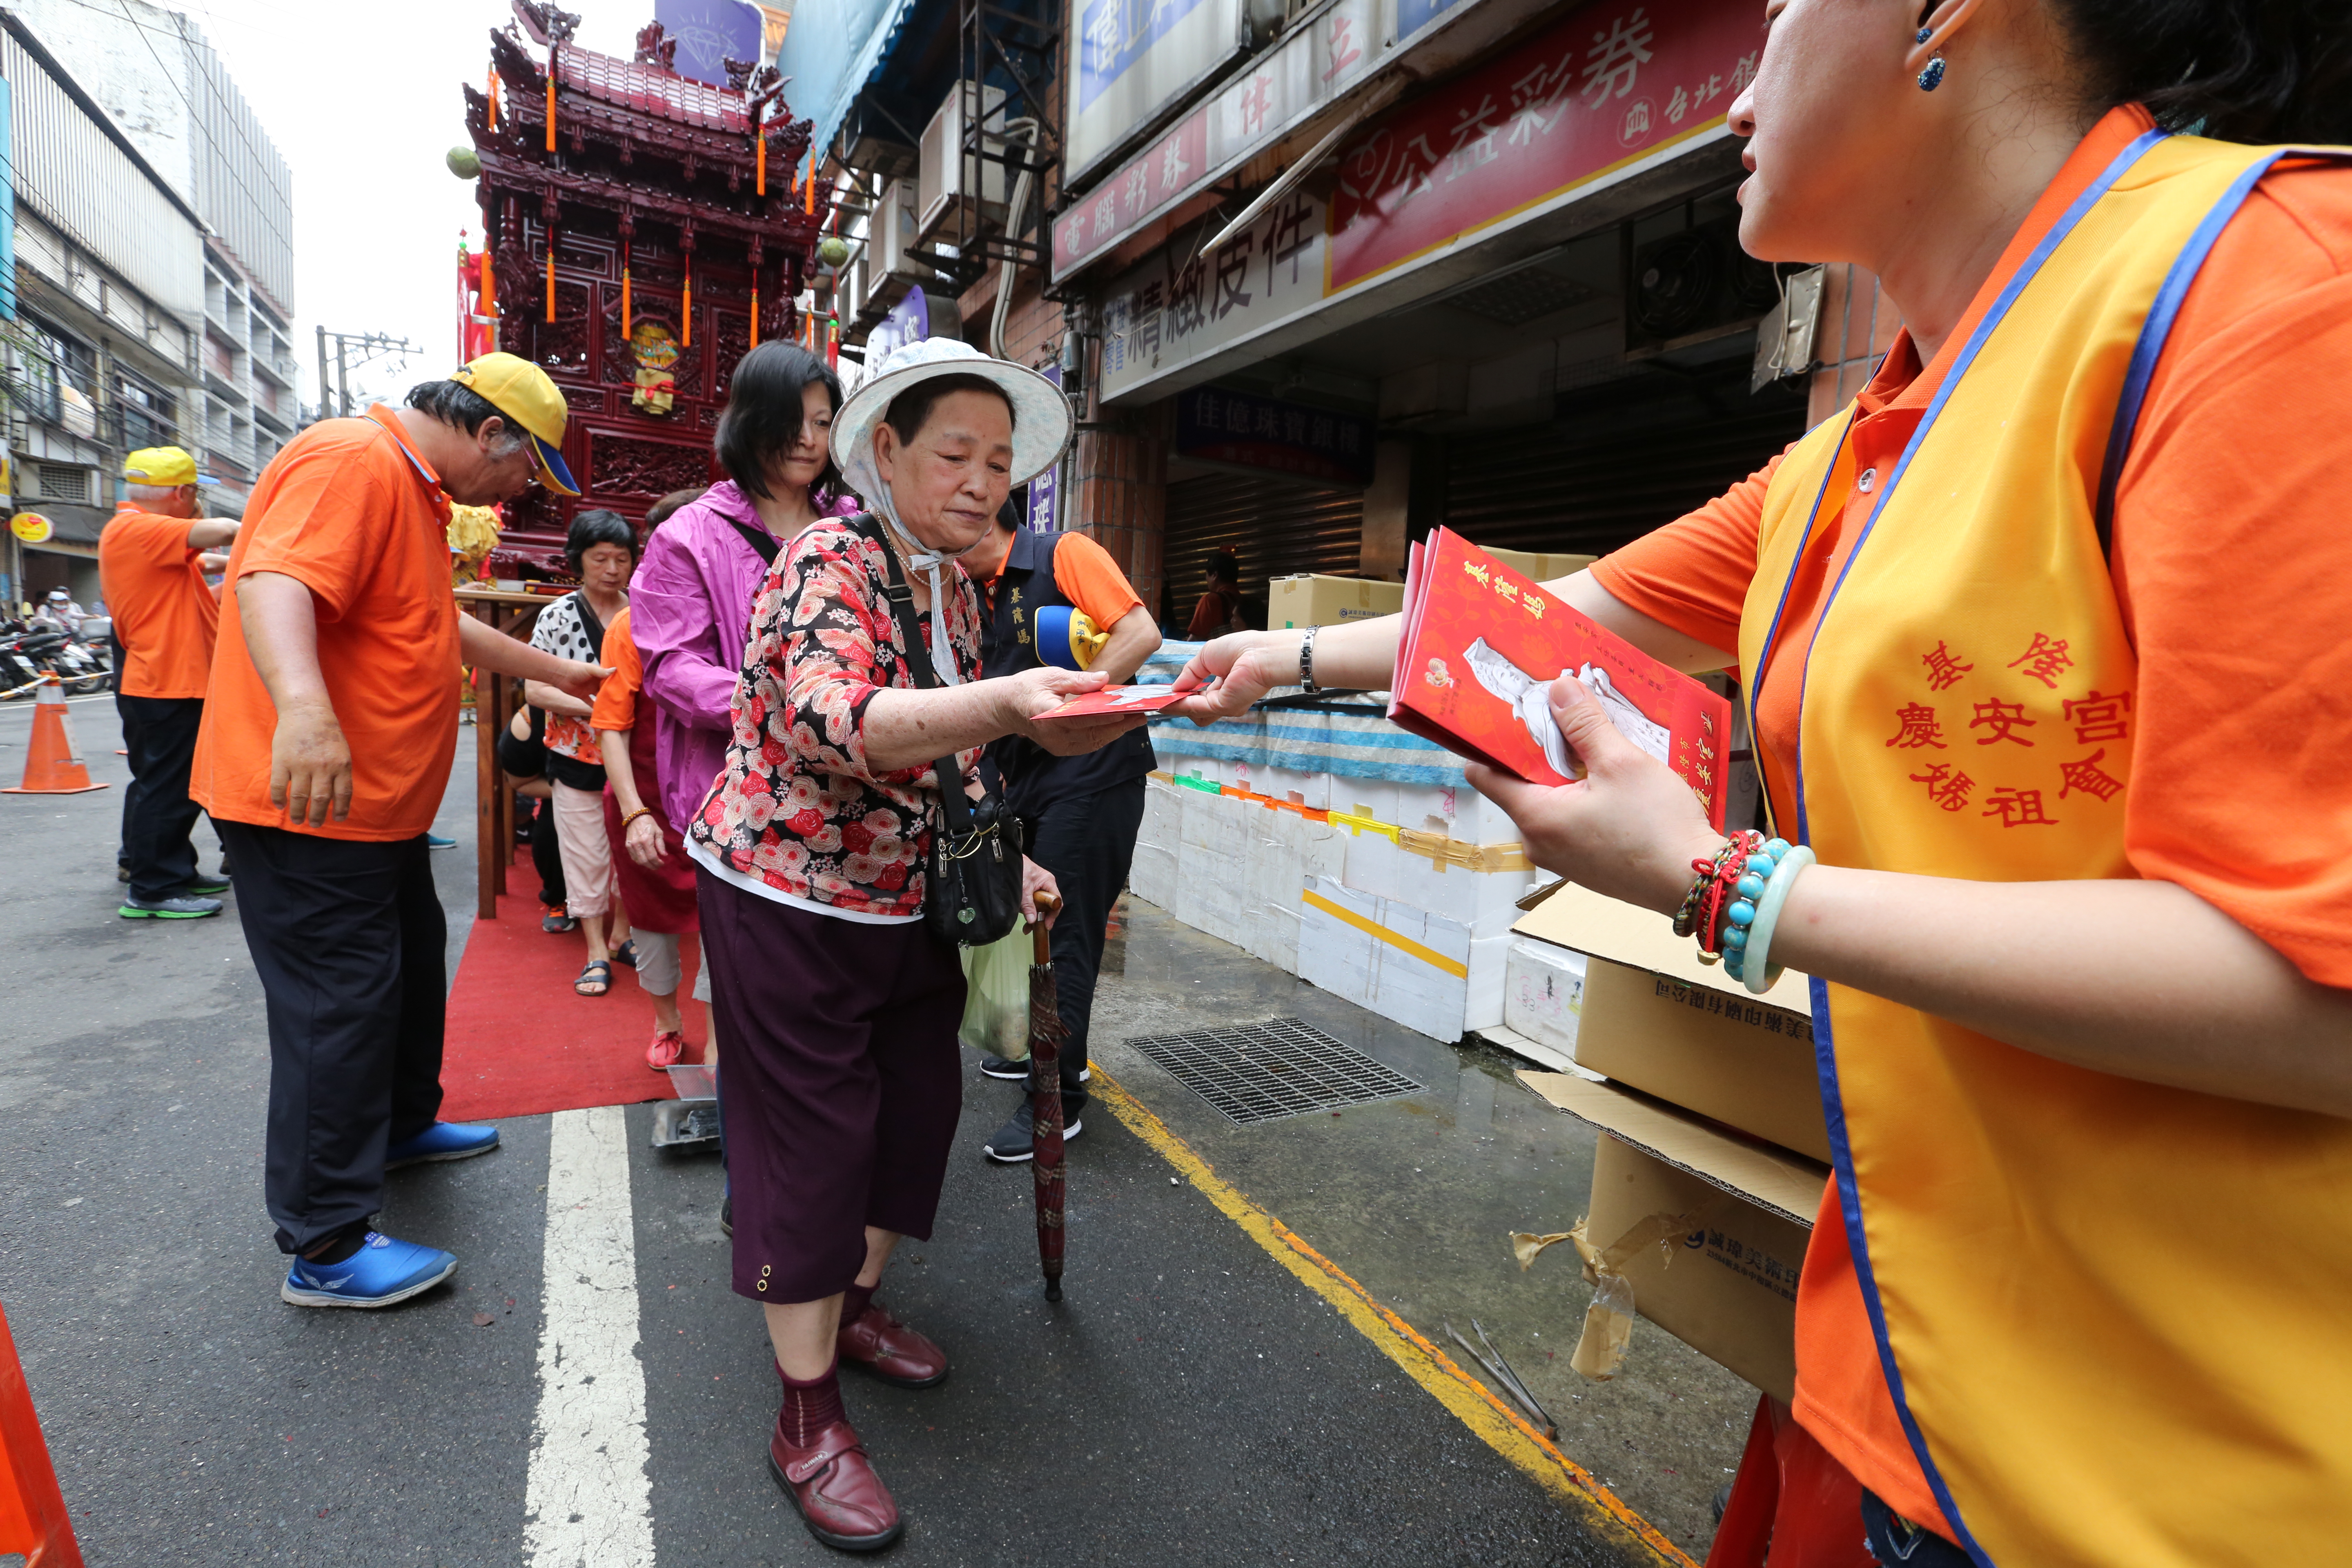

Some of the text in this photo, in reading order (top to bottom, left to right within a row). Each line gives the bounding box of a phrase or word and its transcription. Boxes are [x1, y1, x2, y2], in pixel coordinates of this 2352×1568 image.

[1065, 17, 1361, 256] 電腦彩券 偉立
[1391, 7, 1654, 211] 公益彩券
[1128, 193, 1313, 363] 精緻皮件
[1195, 392, 1361, 455] 佳億珠寶銀樓
[1011, 586, 1030, 644] 基隆媽
[1464, 560, 1546, 620] 基隆媽
[1922, 632, 2074, 692] 基隆
[1886, 690, 2131, 749] 慶安宮
[1909, 748, 2125, 828] 媽祖會
